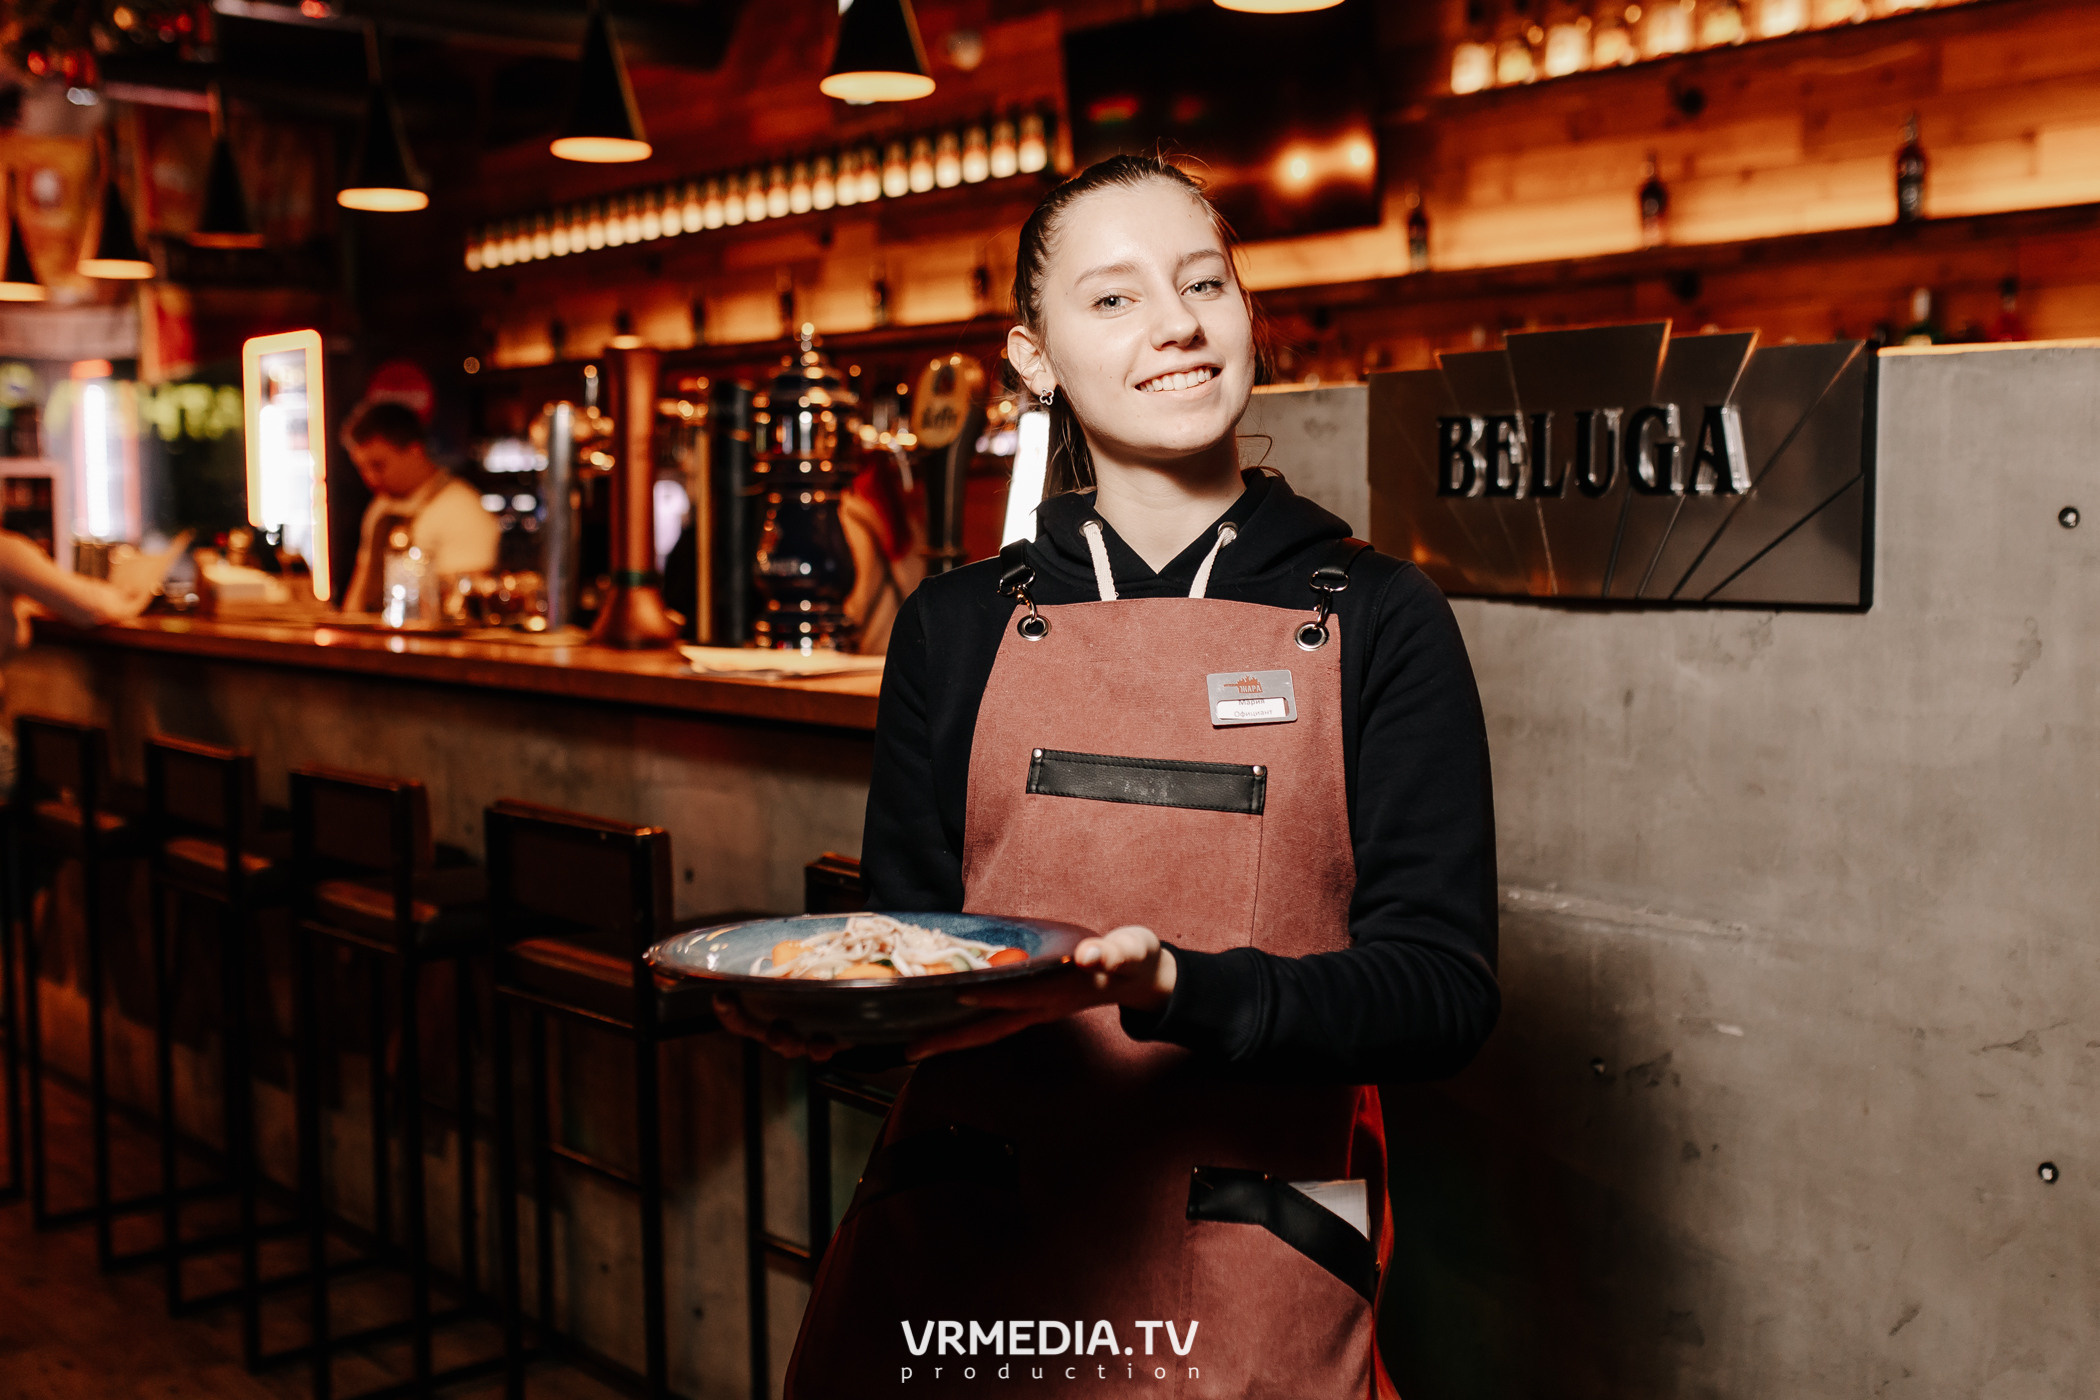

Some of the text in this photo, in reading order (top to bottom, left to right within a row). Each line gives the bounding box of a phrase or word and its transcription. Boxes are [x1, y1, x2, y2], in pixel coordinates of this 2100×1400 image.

[1437, 402, 1755, 499] BELUGA
[1240, 684, 1262, 693] ЖАРА
[1234, 710, 1273, 718] Официант
